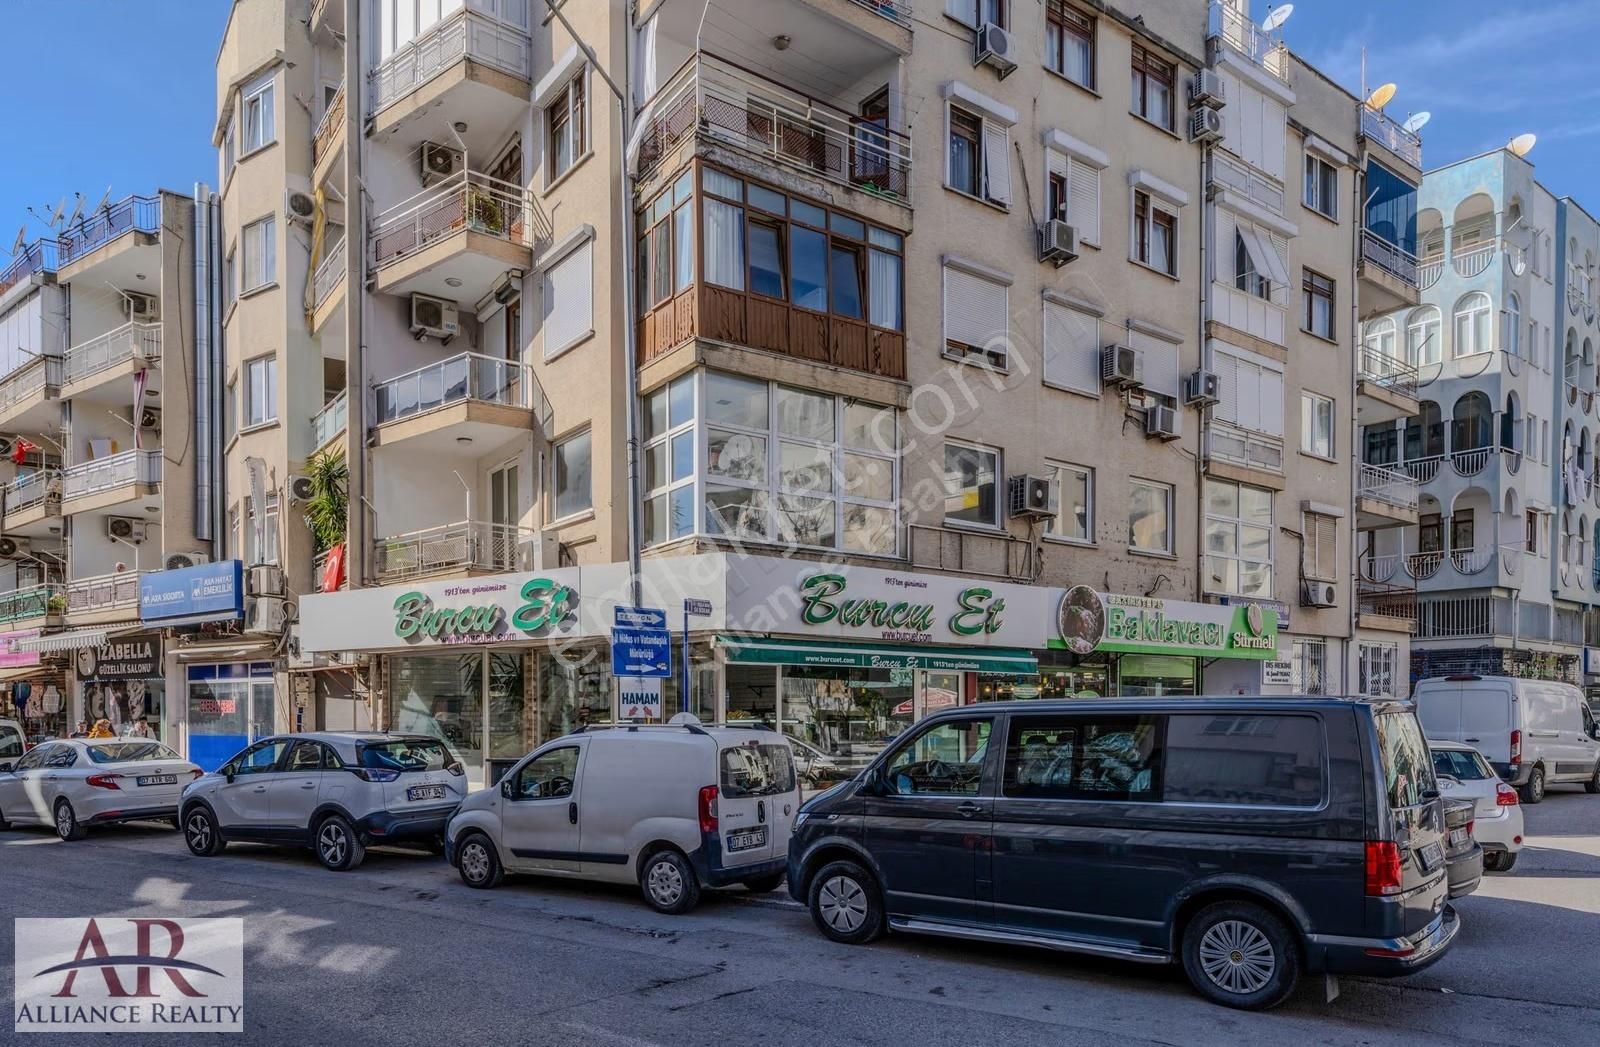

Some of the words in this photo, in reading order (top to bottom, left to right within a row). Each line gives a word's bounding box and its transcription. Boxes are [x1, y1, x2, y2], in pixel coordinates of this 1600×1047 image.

[393, 591, 500, 638] Burcu
[512, 578, 575, 632] Et
[800, 573, 936, 632] Burcu
[948, 587, 1006, 636] Et
[1108, 607, 1226, 647] Baklavacı
[871, 655, 900, 668] Burcu
[905, 656, 918, 668] Et
[621, 692, 659, 705] HAMAM
